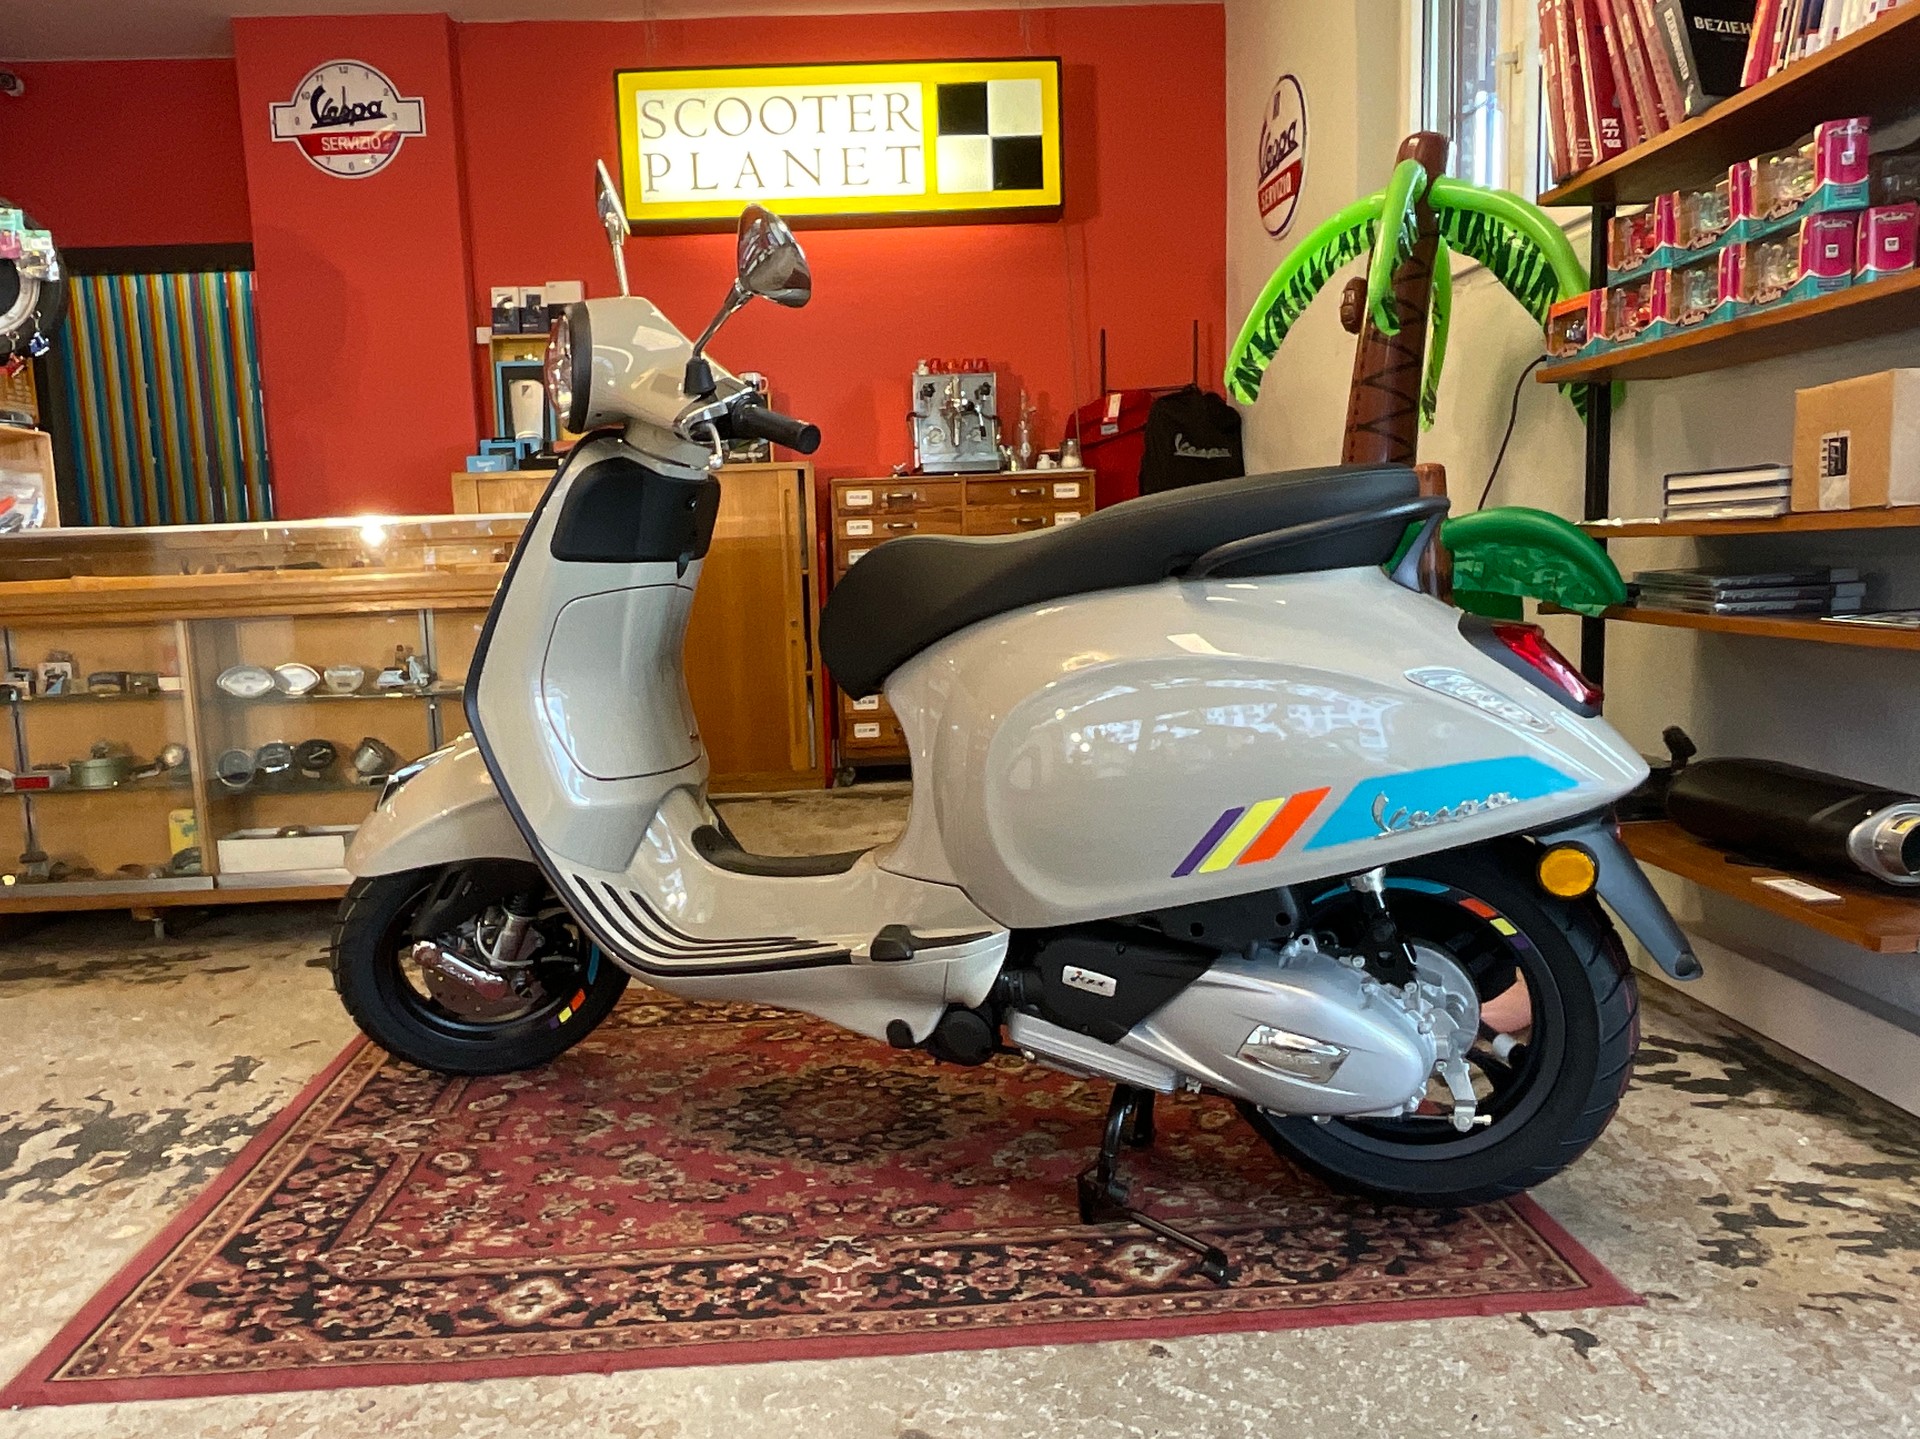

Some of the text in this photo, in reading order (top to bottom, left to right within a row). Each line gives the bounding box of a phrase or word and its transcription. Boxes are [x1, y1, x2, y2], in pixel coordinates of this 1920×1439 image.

[338, 65, 349, 74] 12
[315, 74, 324, 82] 11
[364, 71, 370, 80] 1
[300, 91, 311, 100] 10
[382, 88, 389, 97] 2
[310, 84, 388, 130] Vespa
[640, 91, 921, 140] SCOOTER
[320, 135, 382, 152] SERVIZIO
[370, 154, 378, 164] 5
[643, 144, 921, 193] PLANET
